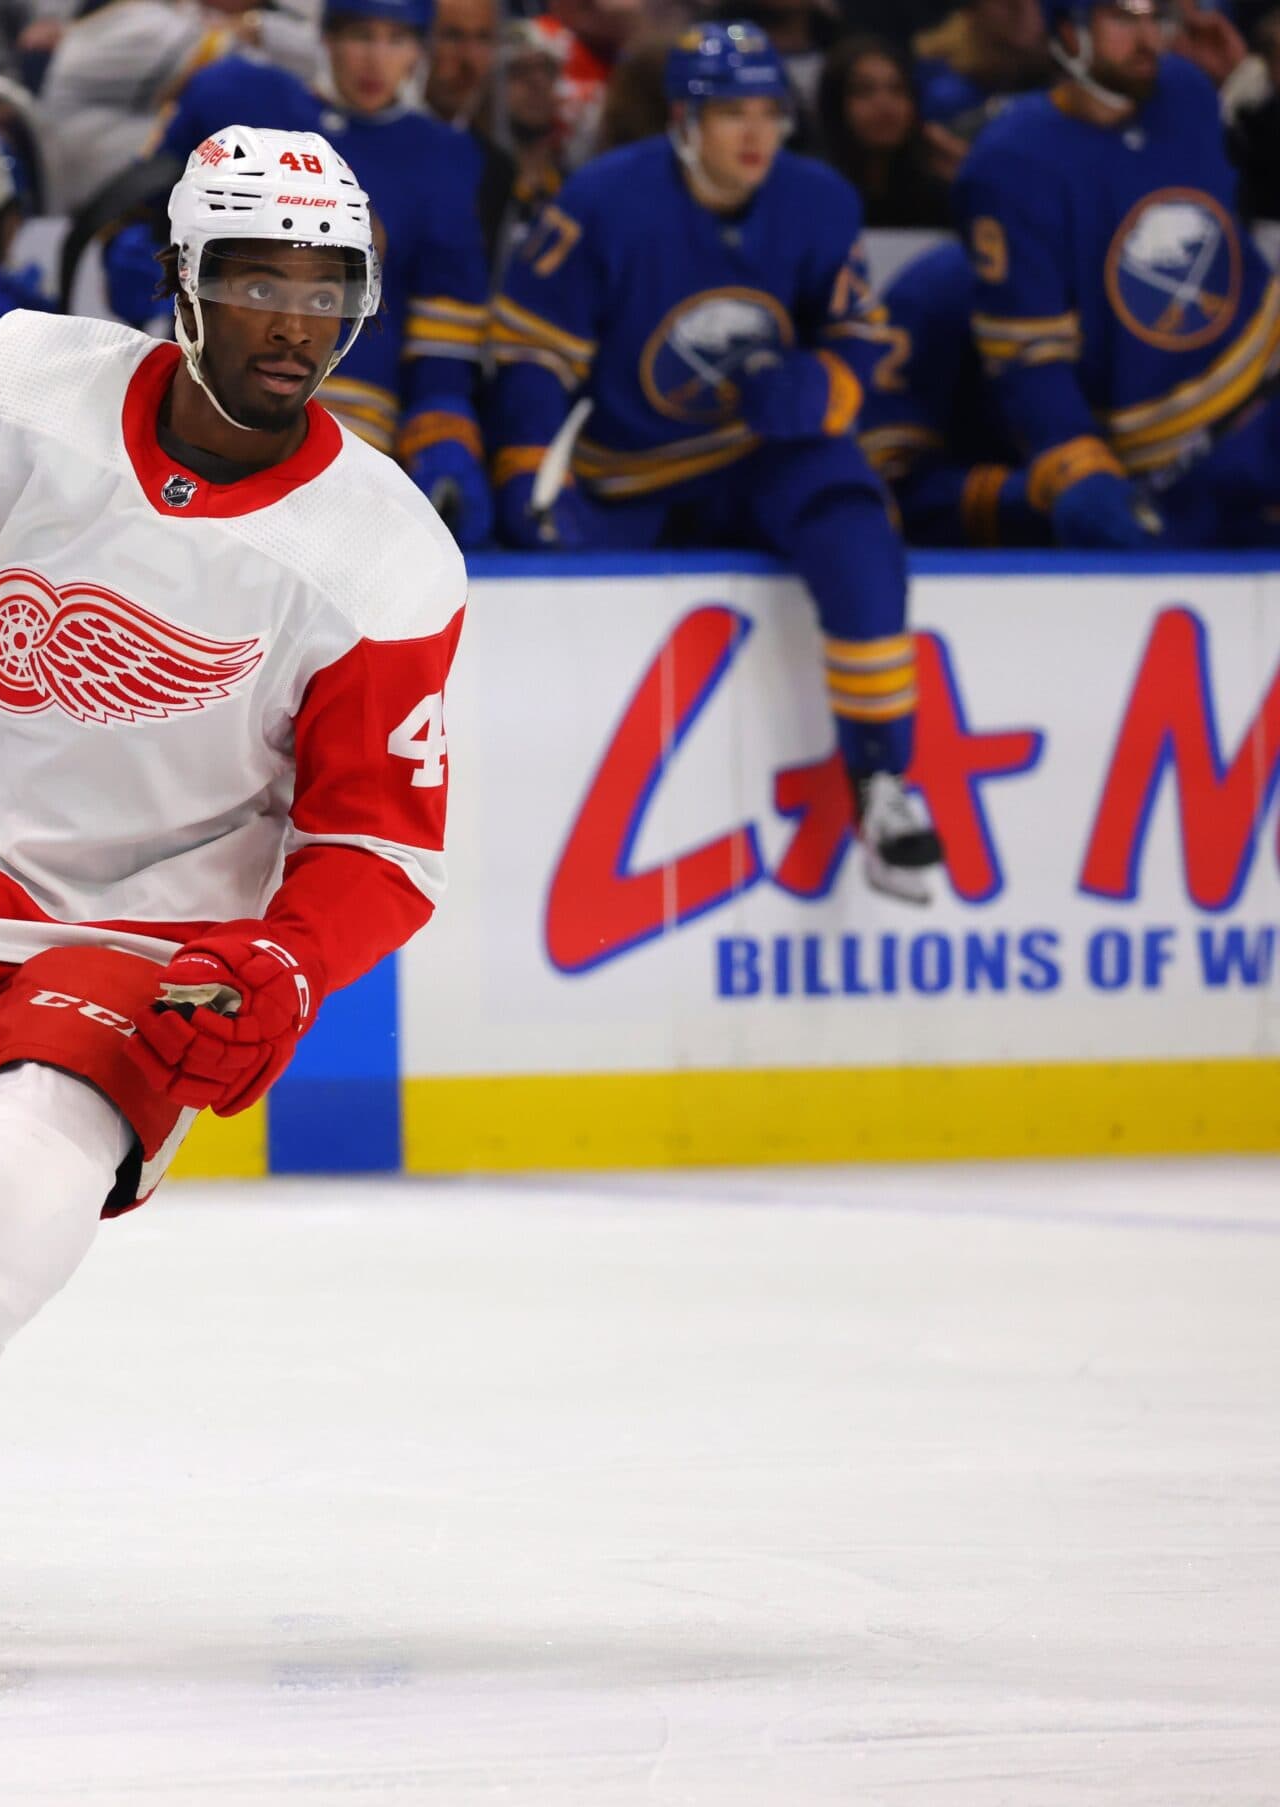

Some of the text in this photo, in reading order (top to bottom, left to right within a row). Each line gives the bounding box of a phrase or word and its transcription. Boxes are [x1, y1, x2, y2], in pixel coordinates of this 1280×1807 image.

[279, 151, 323, 174] 48
[276, 195, 338, 209] BAUER
[250, 938, 310, 1033] CC
[716, 932, 1062, 997] BILLIONS
[1088, 928, 1174, 990] OF
